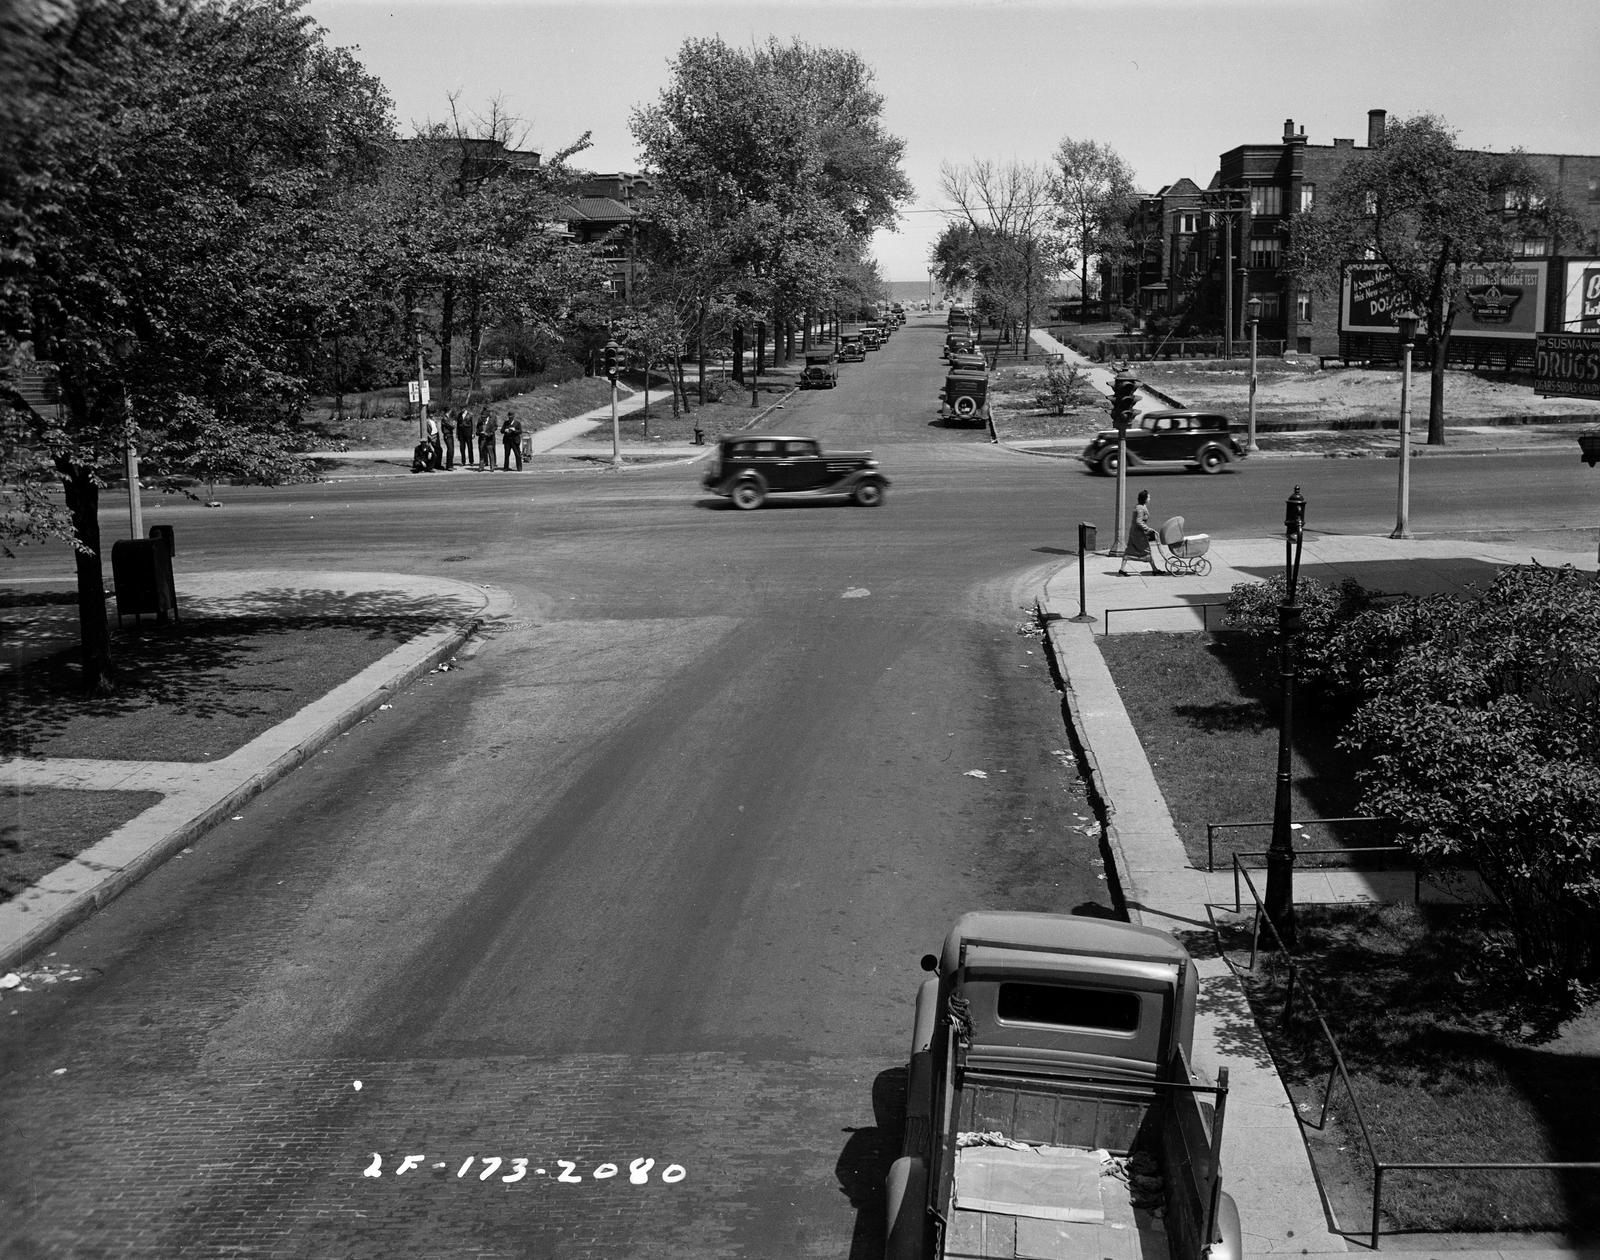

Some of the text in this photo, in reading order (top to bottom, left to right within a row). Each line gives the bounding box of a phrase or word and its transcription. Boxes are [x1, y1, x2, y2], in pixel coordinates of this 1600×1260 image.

[1525, 274, 1538, 286] TEST
[1547, 338, 1590, 350] SUSMAN
[1538, 351, 1599, 380] DRUGS
